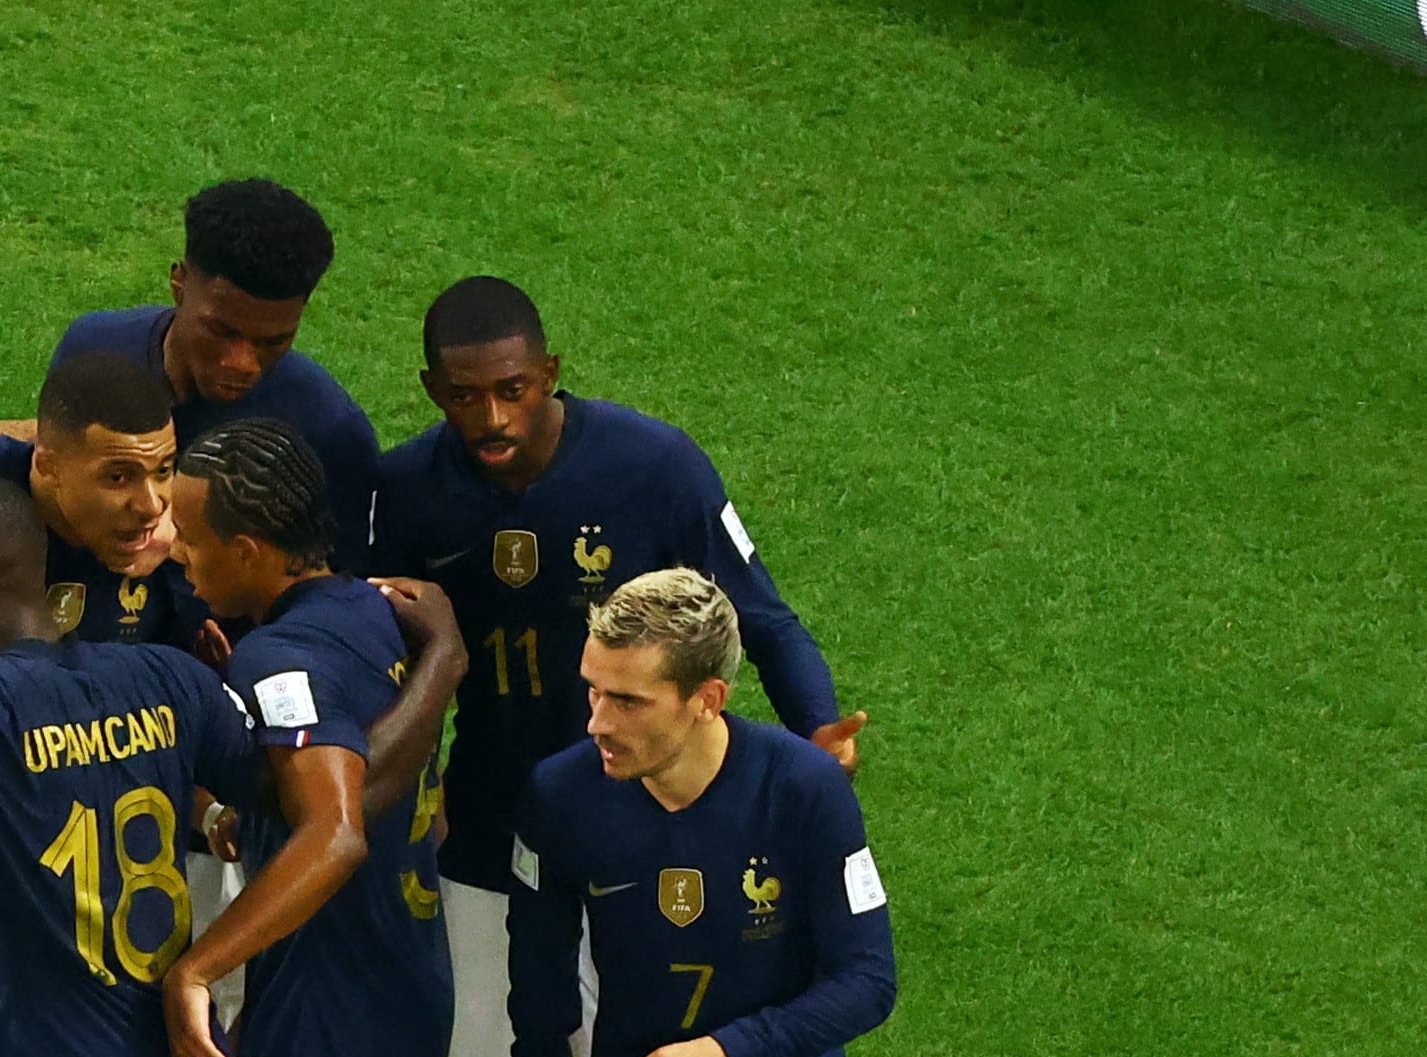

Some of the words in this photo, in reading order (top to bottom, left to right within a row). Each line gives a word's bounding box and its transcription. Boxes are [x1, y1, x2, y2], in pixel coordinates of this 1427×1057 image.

[483, 627, 543, 697] 11
[23, 704, 177, 773] UPAMCANO
[39, 785, 192, 986] 18
[671, 903, 692, 913] FIFA
[668, 962, 716, 1030] 7
